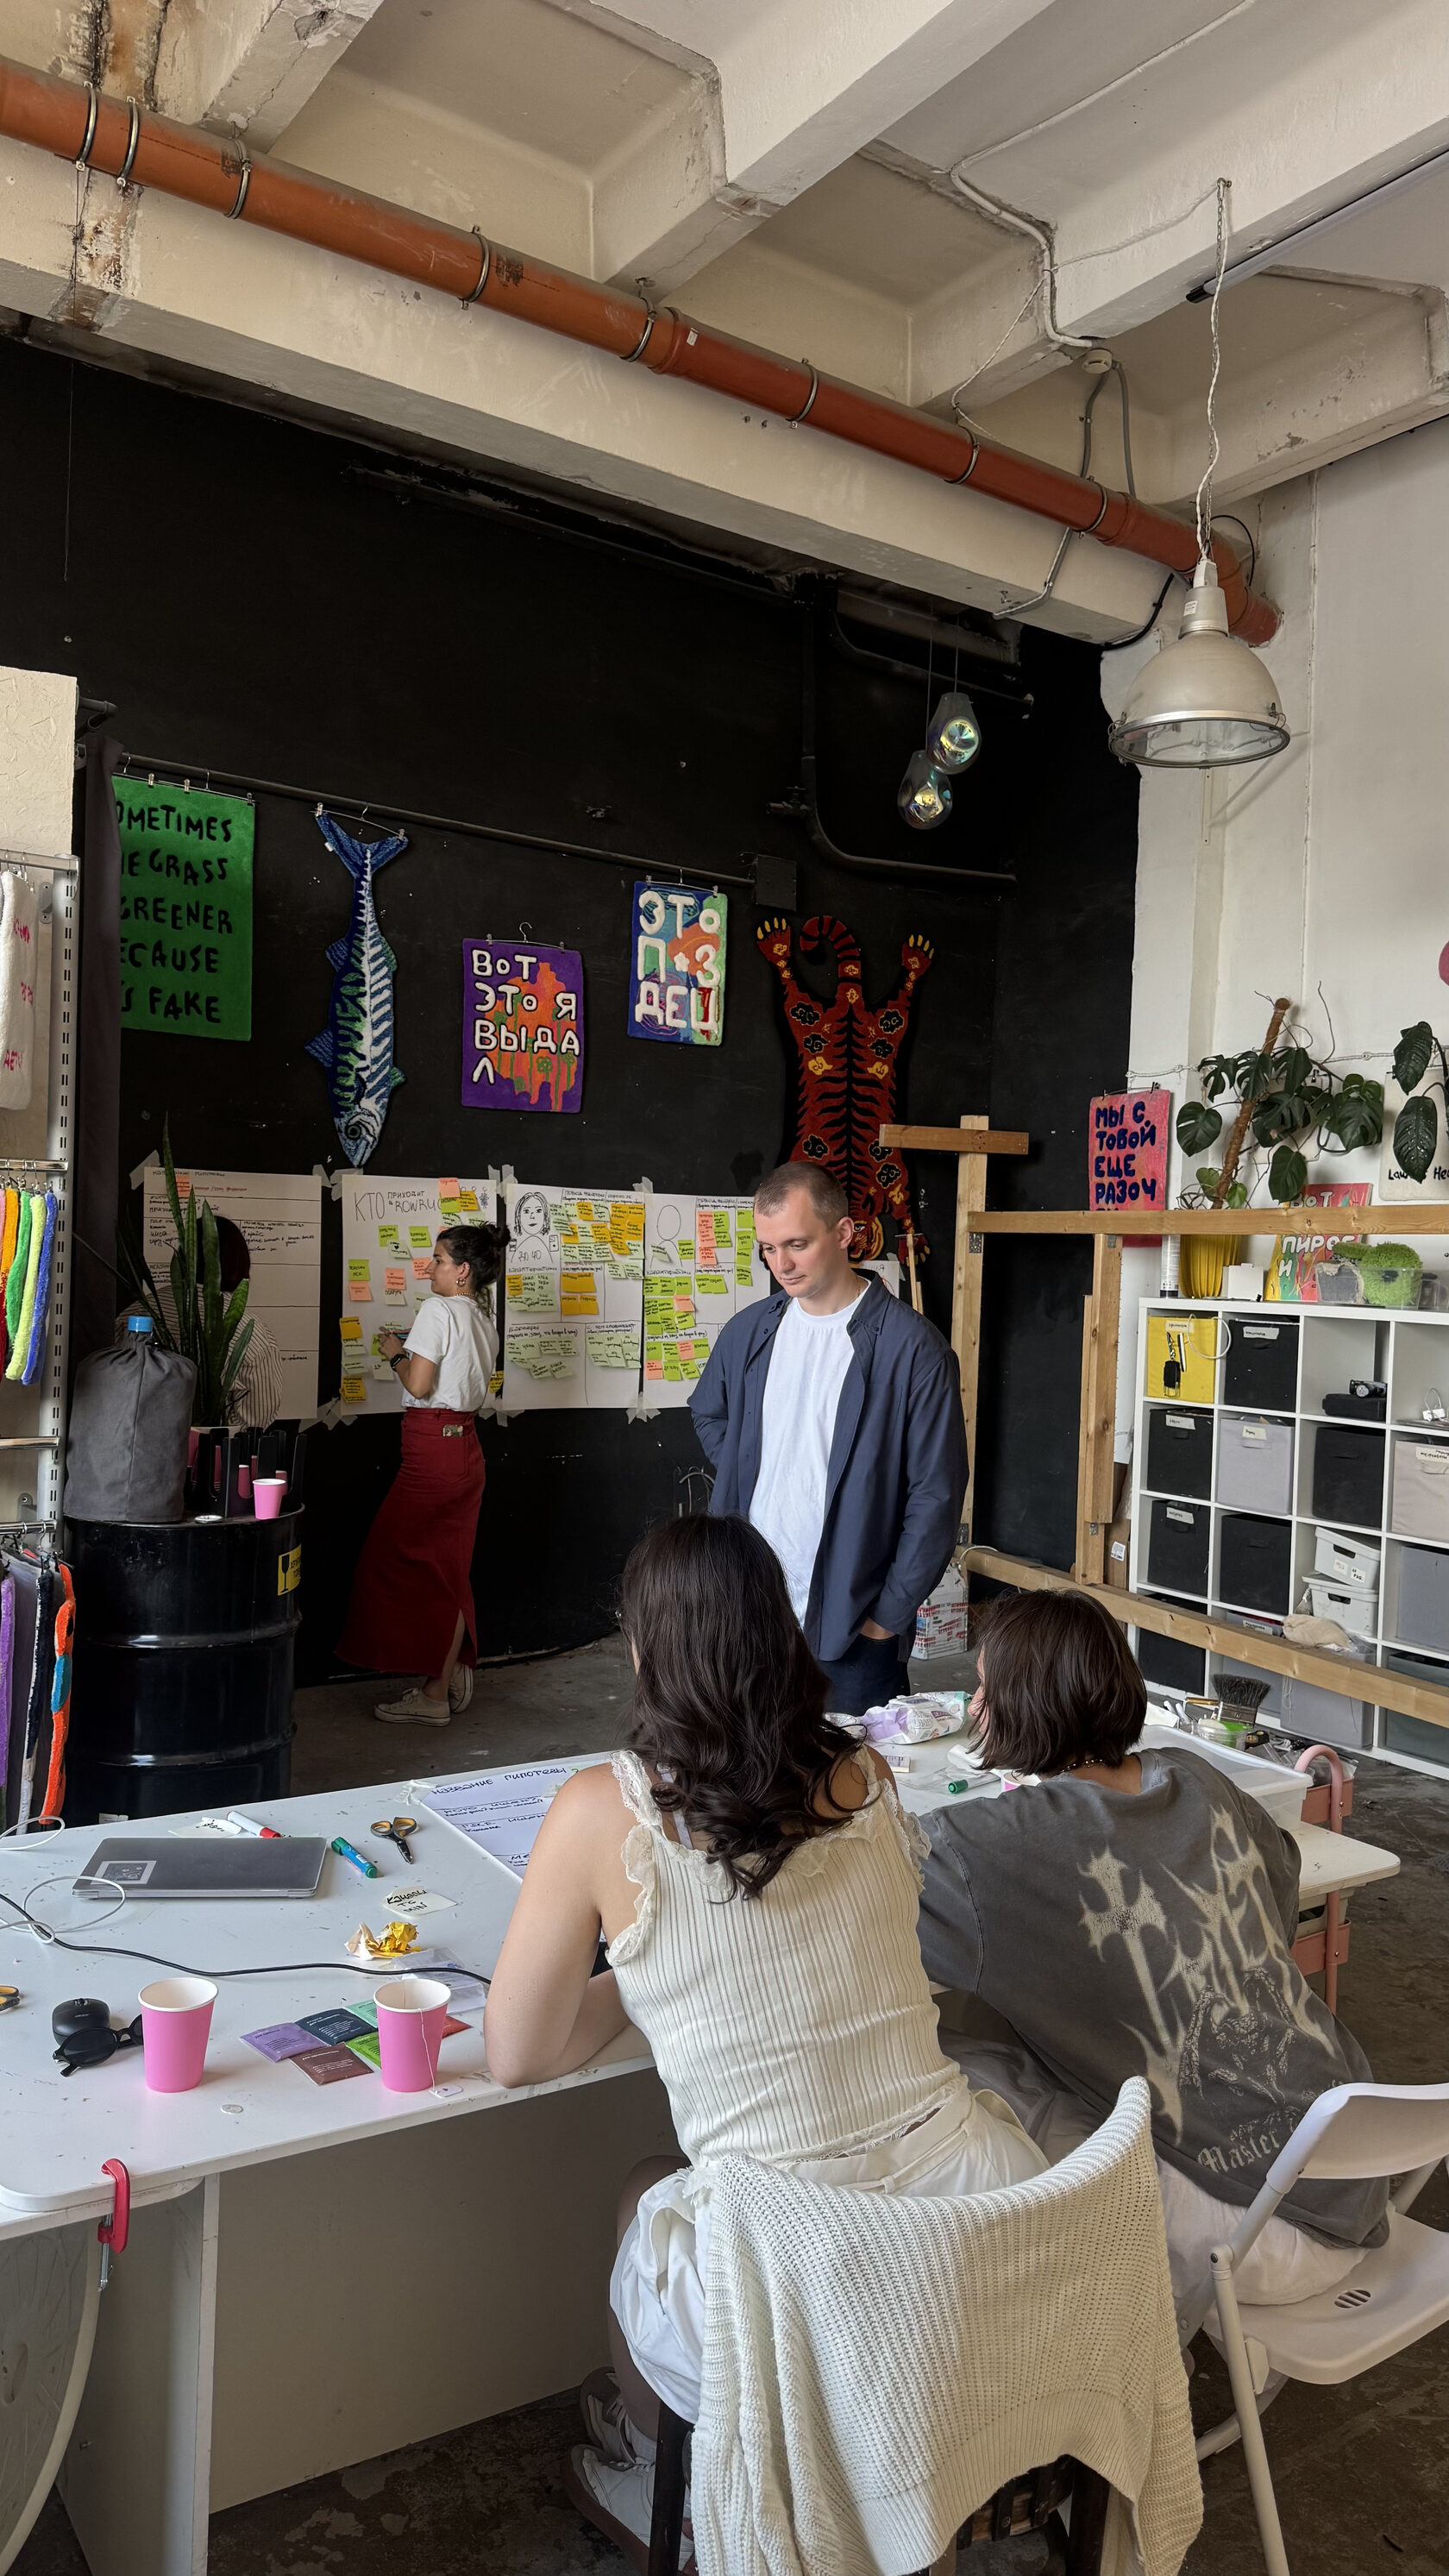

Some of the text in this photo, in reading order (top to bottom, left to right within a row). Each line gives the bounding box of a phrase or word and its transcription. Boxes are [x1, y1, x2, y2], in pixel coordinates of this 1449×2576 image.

[148, 849, 228, 886] GRASS
[148, 986, 221, 1023] FAKE
[555, 992, 576, 1020] Я
[635, 981, 718, 1031] ДЕЦ
[475, 1019, 580, 1055] ВЫДА
[472, 1056, 494, 1084] Л
[1095, 1104, 1125, 1128] МЫ
[1095, 1120, 1156, 1151] ТОБОЙ
[1095, 1154, 1136, 1178] ЕЩЕ
[1095, 1178, 1157, 1204] РАЗОЧ
[354, 1192, 386, 1222] КТО
[431, 1767, 567, 1794] НАЗВАНИЕ ГИПОТЕЗЫ
